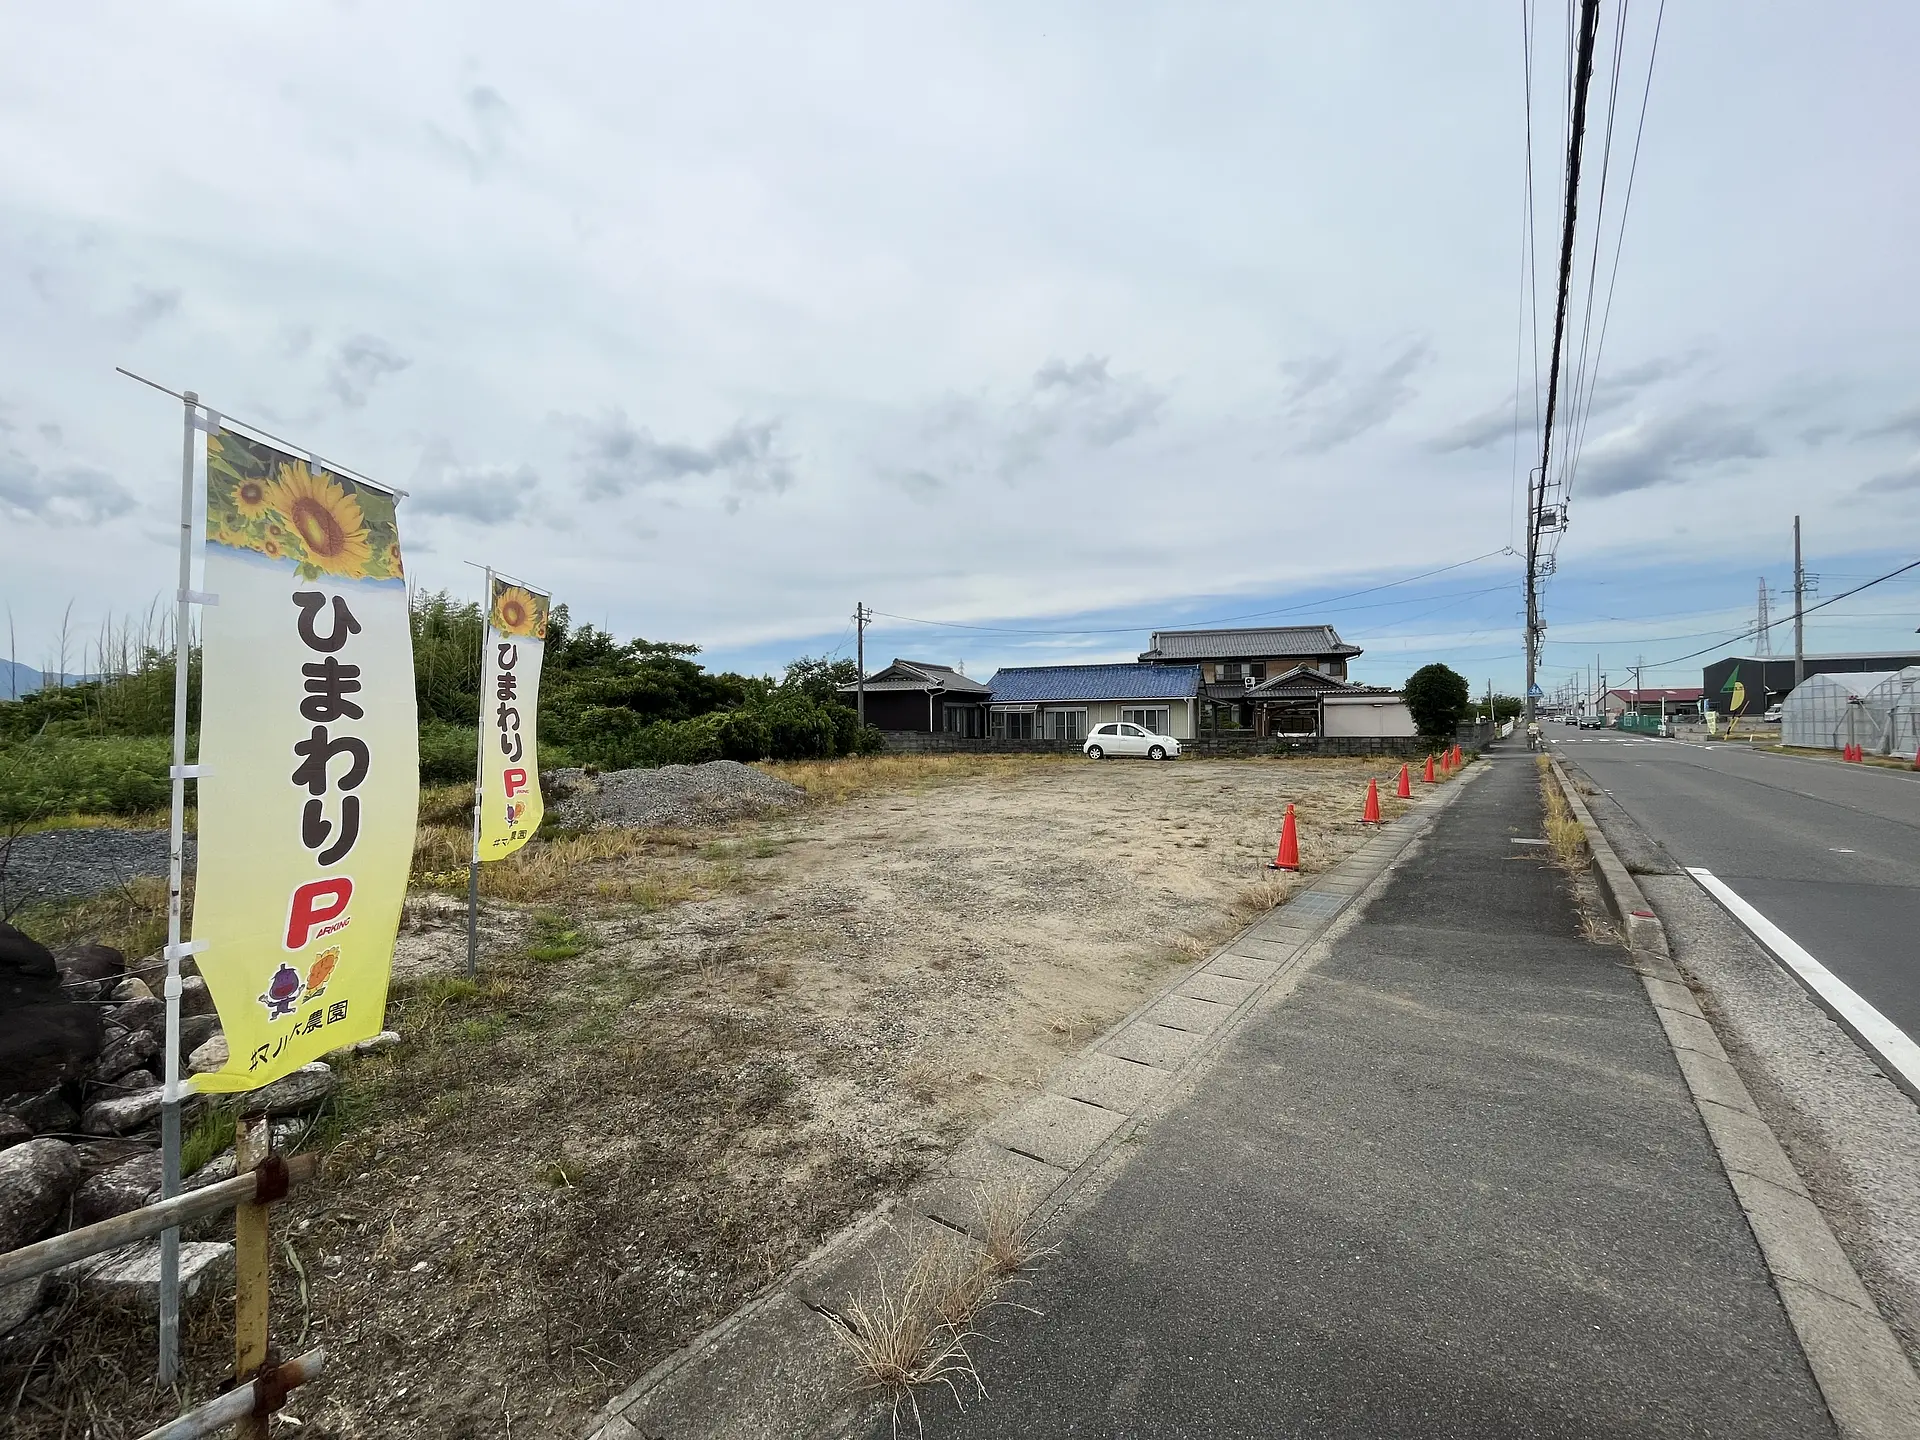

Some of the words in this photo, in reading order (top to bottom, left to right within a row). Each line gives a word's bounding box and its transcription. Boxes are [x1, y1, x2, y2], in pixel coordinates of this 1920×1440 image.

[291, 590, 370, 867] ひまわり
[496, 643, 522, 763] ひまわり
[503, 768, 527, 798] P
[286, 877, 353, 949] P
